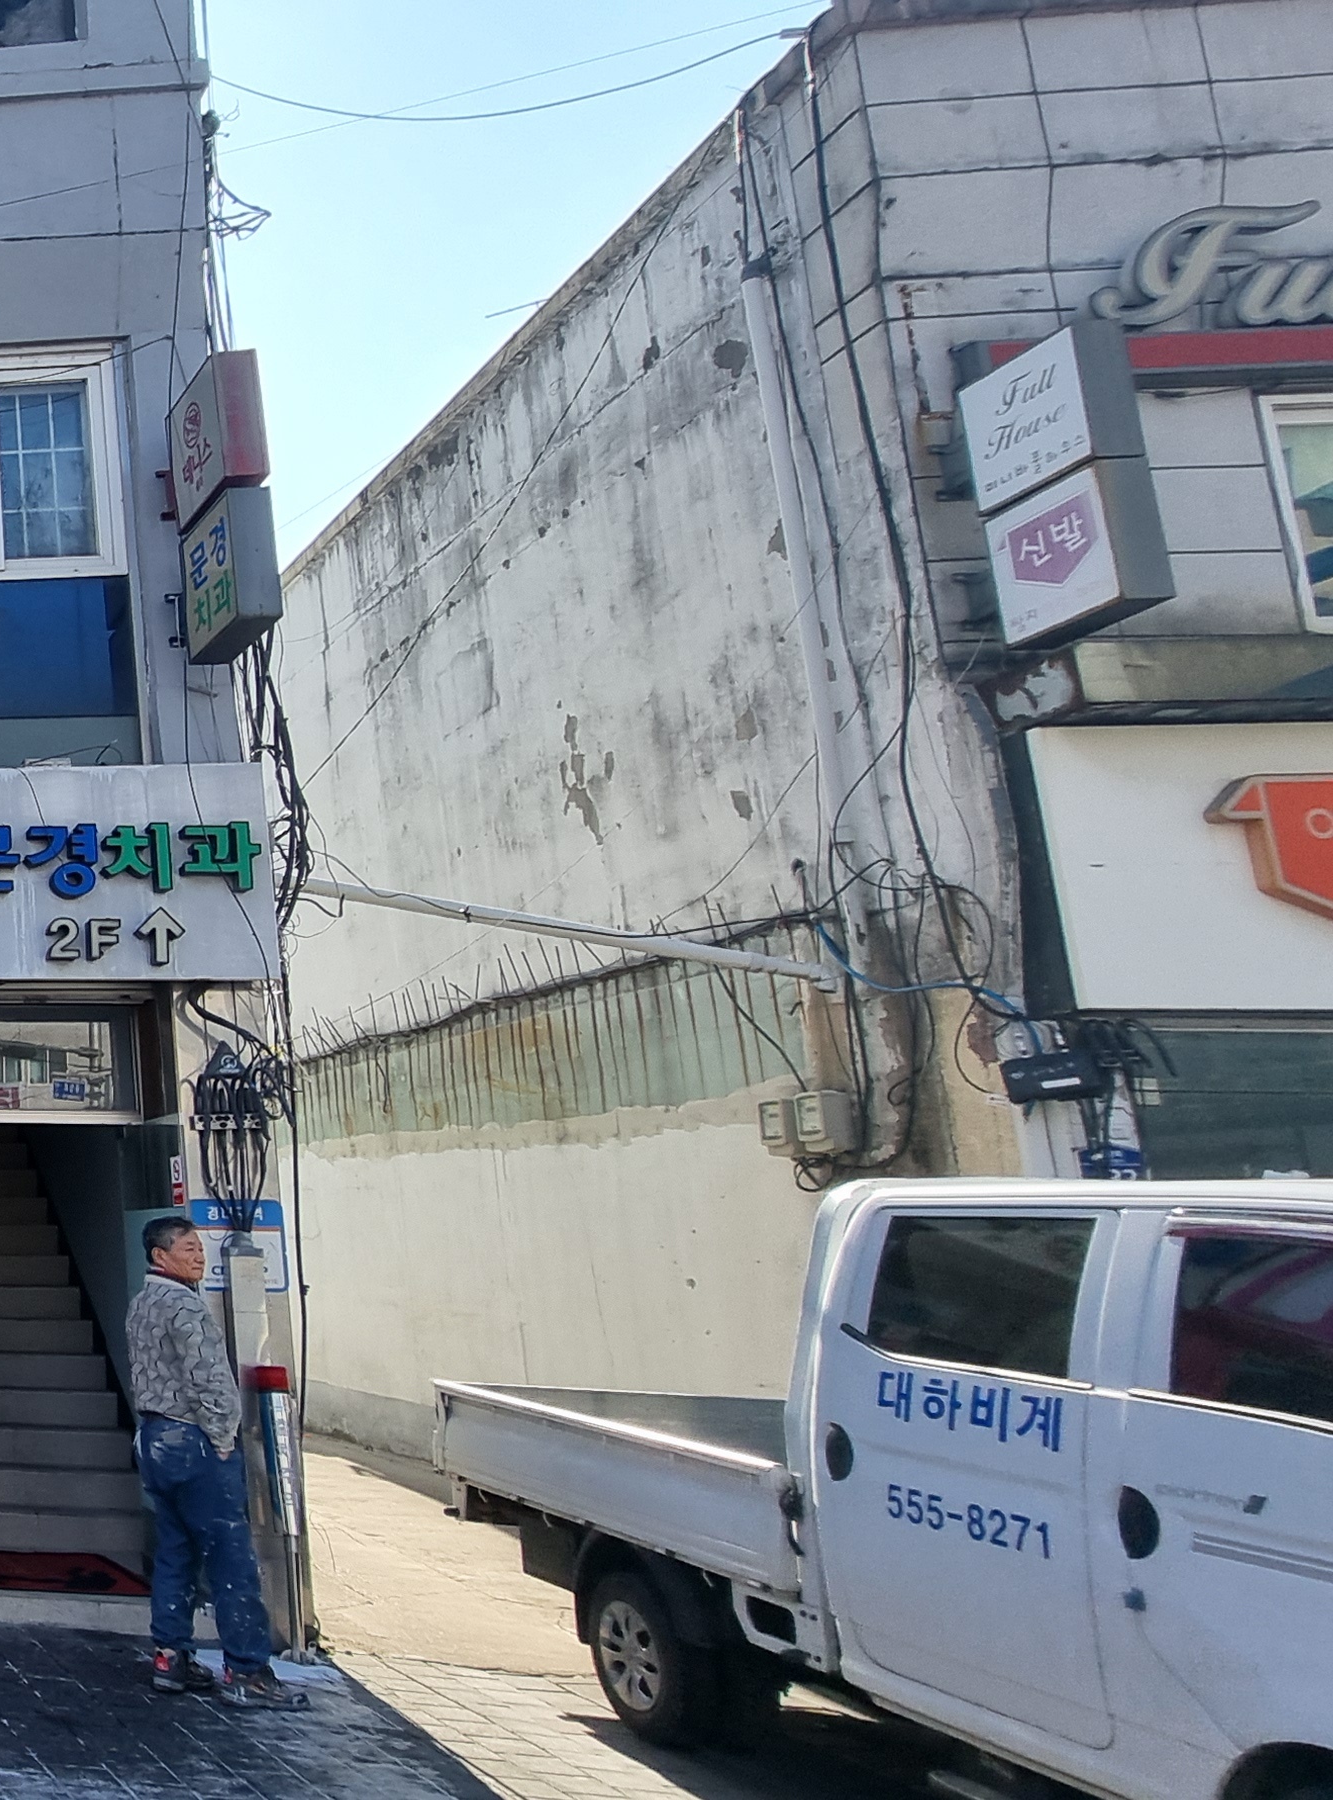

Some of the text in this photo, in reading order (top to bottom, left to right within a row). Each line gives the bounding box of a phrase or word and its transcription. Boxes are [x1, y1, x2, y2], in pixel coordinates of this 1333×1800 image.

[994, 363, 1057, 417] Full
[983, 403, 1067, 460] House
[189, 515, 227, 591] 문경
[1019, 510, 1088, 568] 신발
[193, 569, 232, 632] 치과
[45, 916, 121, 962] 2F
[876, 1370, 1064, 1452] 대하비계
[885, 1482, 1052, 1560] 555-8271
